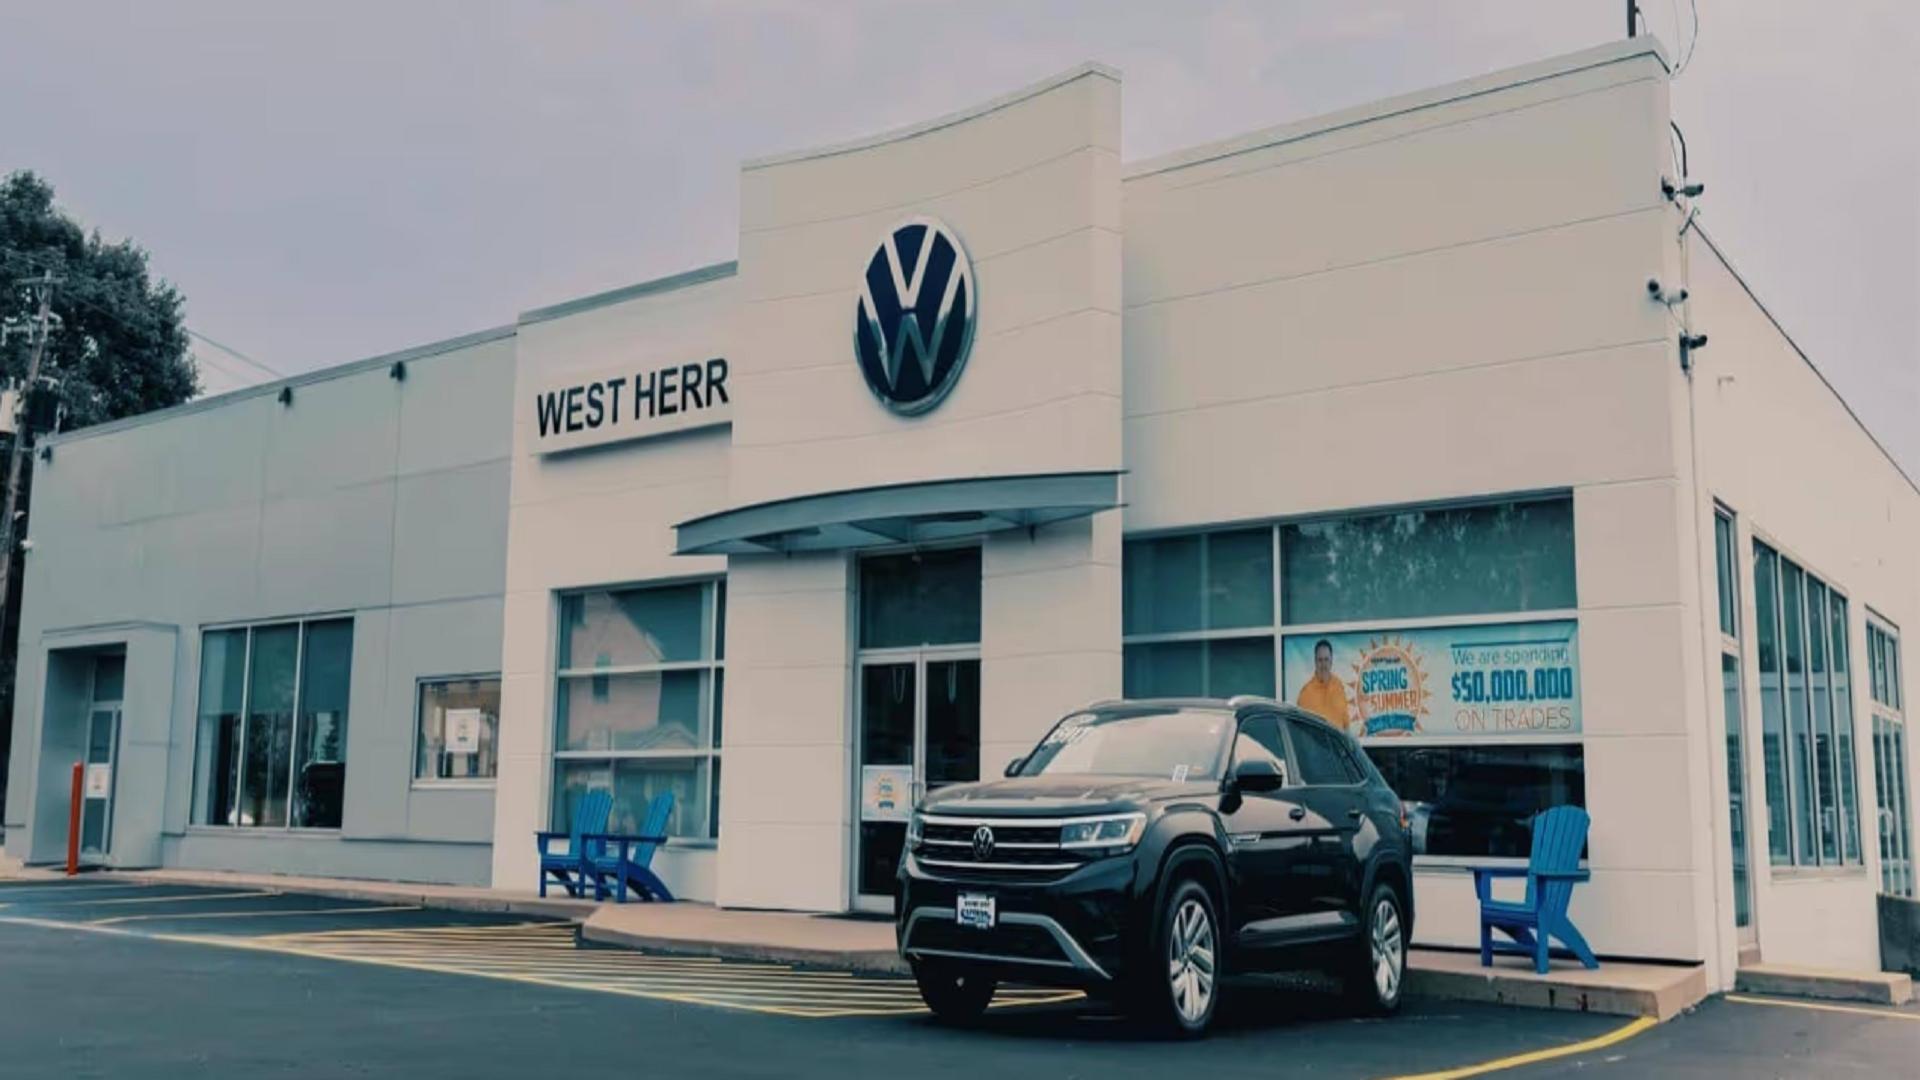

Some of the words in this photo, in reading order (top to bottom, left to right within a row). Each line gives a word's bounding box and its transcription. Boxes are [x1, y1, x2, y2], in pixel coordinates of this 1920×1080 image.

[537, 378, 626, 437] WEST
[635, 358, 729, 420] HERR
[1452, 649, 1474, 665] We
[1479, 651, 1500, 665] are
[1504, 647, 1569, 665] spending
[1362, 667, 1408, 694] SPRING
[1451, 667, 1573, 704] $50,000,000
[1371, 690, 1417, 712] SUMMER
[1455, 707, 1486, 731] ON
[1491, 706, 1571, 731] TRADES
